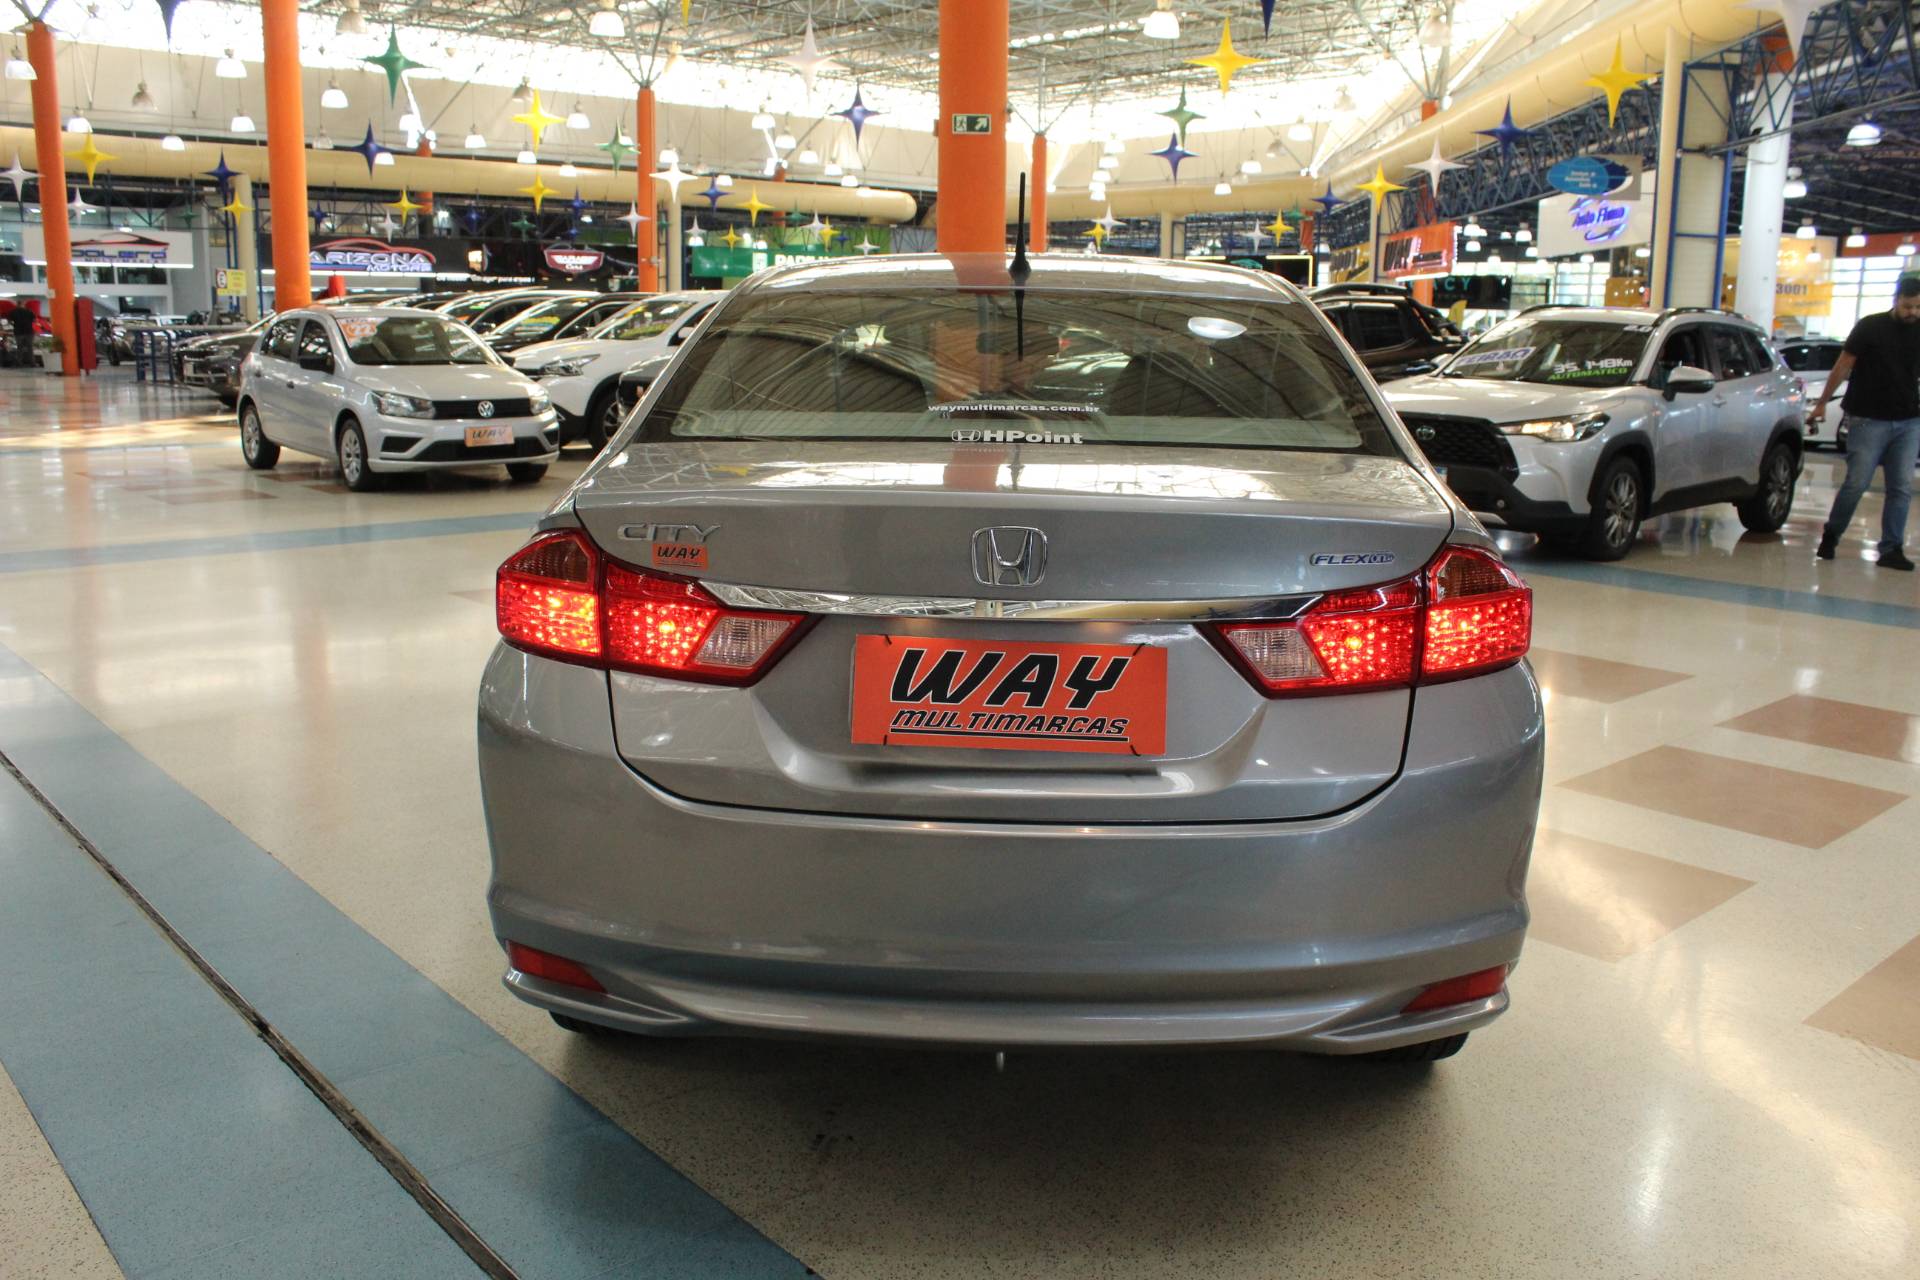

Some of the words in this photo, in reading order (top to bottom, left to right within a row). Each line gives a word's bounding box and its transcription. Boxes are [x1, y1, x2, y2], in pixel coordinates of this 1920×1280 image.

[308, 250, 433, 266] ARIZONA
[366, 263, 432, 272] MOTORS
[928, 402, 1100, 413] waymultimarcas.com.br
[983, 429, 1084, 444] HPoint
[617, 523, 720, 542] CITY
[657, 546, 701, 560] WAY
[890, 647, 1132, 711] WAY
[890, 708, 1129, 736] MULTIMARCAS
